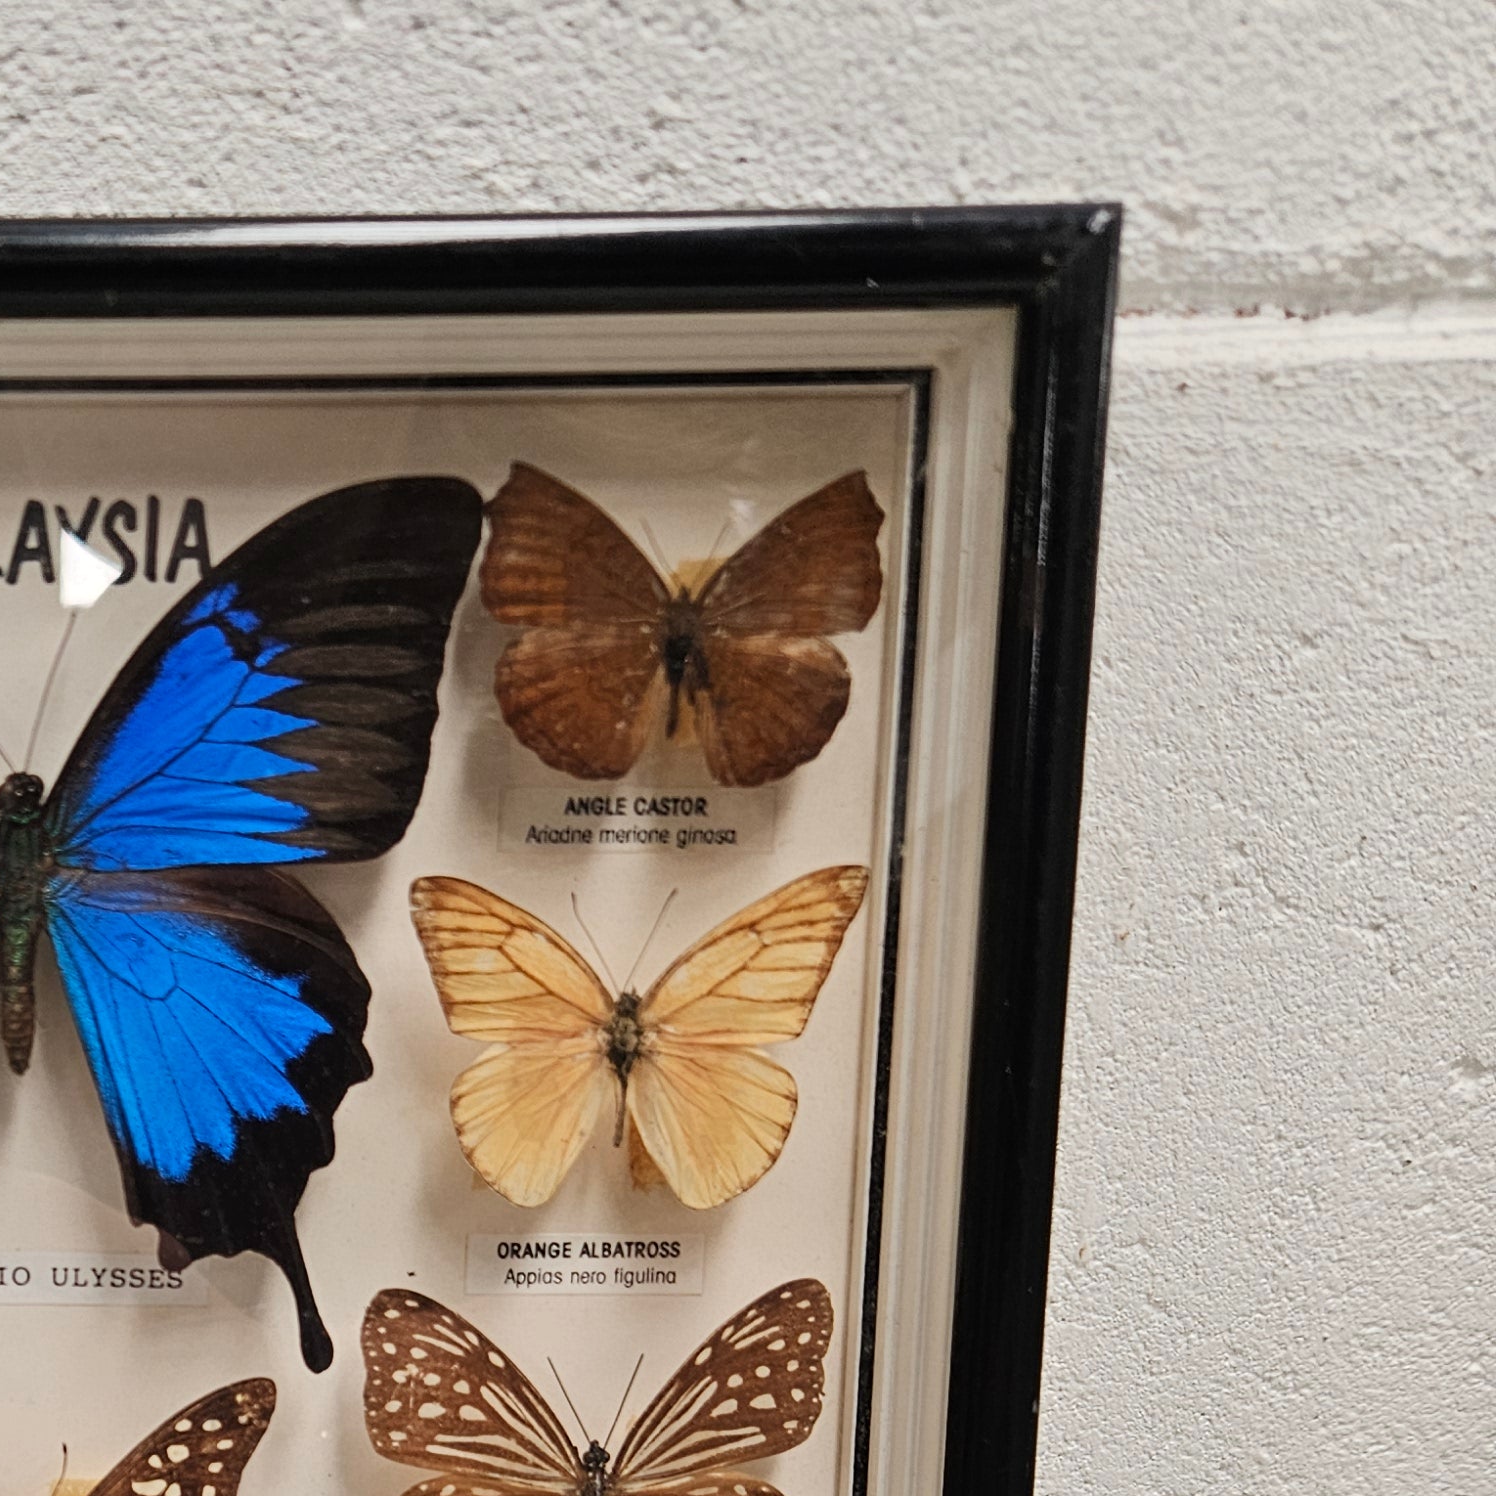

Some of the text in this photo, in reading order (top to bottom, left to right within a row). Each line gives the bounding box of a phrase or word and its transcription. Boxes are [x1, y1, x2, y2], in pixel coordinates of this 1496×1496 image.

[564, 796, 708, 818] ANGLE CASTOR
[525, 824, 736, 848] Ariadne merione ginosa
[497, 1241, 681, 1259] ORANGE ALBATROSS
[51, 1267, 183, 1289] ULYSSES
[504, 1267, 677, 1288] Appias nero figulina
